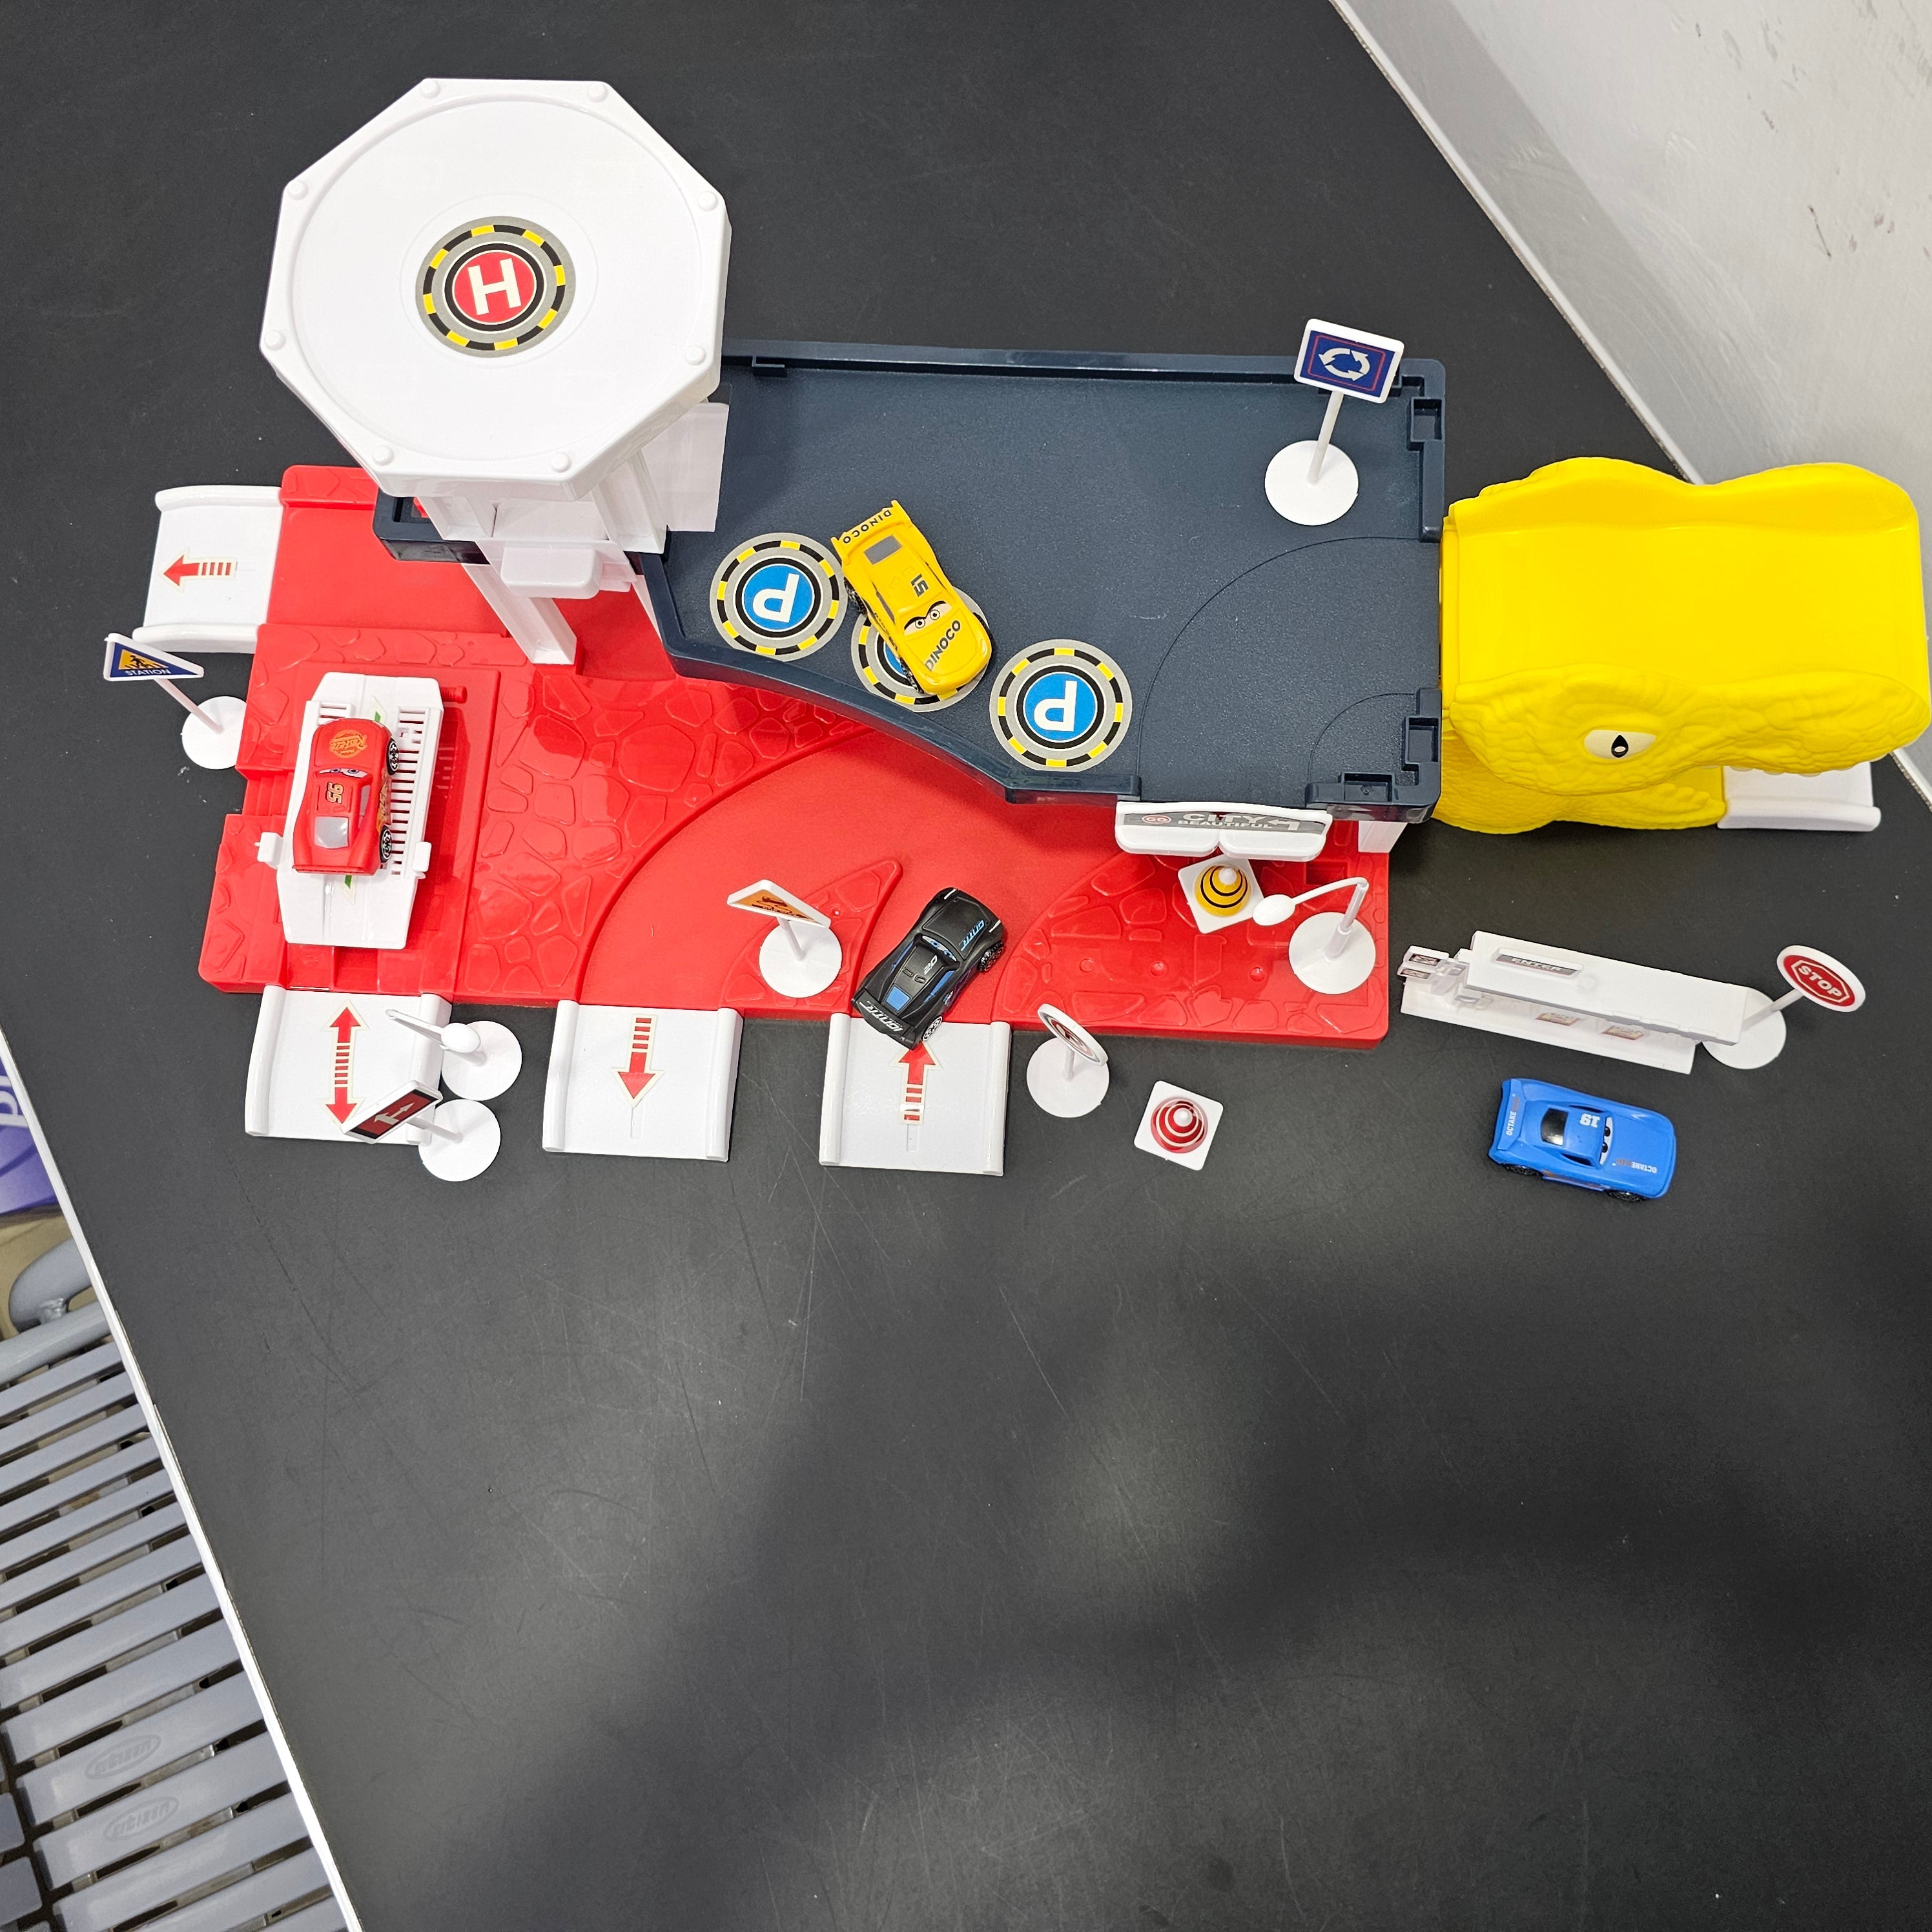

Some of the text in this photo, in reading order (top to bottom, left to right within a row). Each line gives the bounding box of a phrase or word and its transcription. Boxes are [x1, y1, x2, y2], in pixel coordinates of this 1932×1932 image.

[468, 258, 522, 316] H
[843, 509, 892, 544] DINOCO
[753, 573, 799, 622] P
[910, 573, 929, 597] 51
[924, 620, 961, 672] DINOCO
[1033, 681, 1077, 731] P
[327, 782, 344, 804] 95
[1177, 820, 1273, 829] BEAUTIFUL
[1183, 814, 1266, 824] CITY
[1798, 965, 1842, 996] STOP
[1506, 1111, 1517, 1136] OCTANE
[1579, 1113, 1600, 1128] 19
[1631, 1161, 1658, 1174] OCTANE
